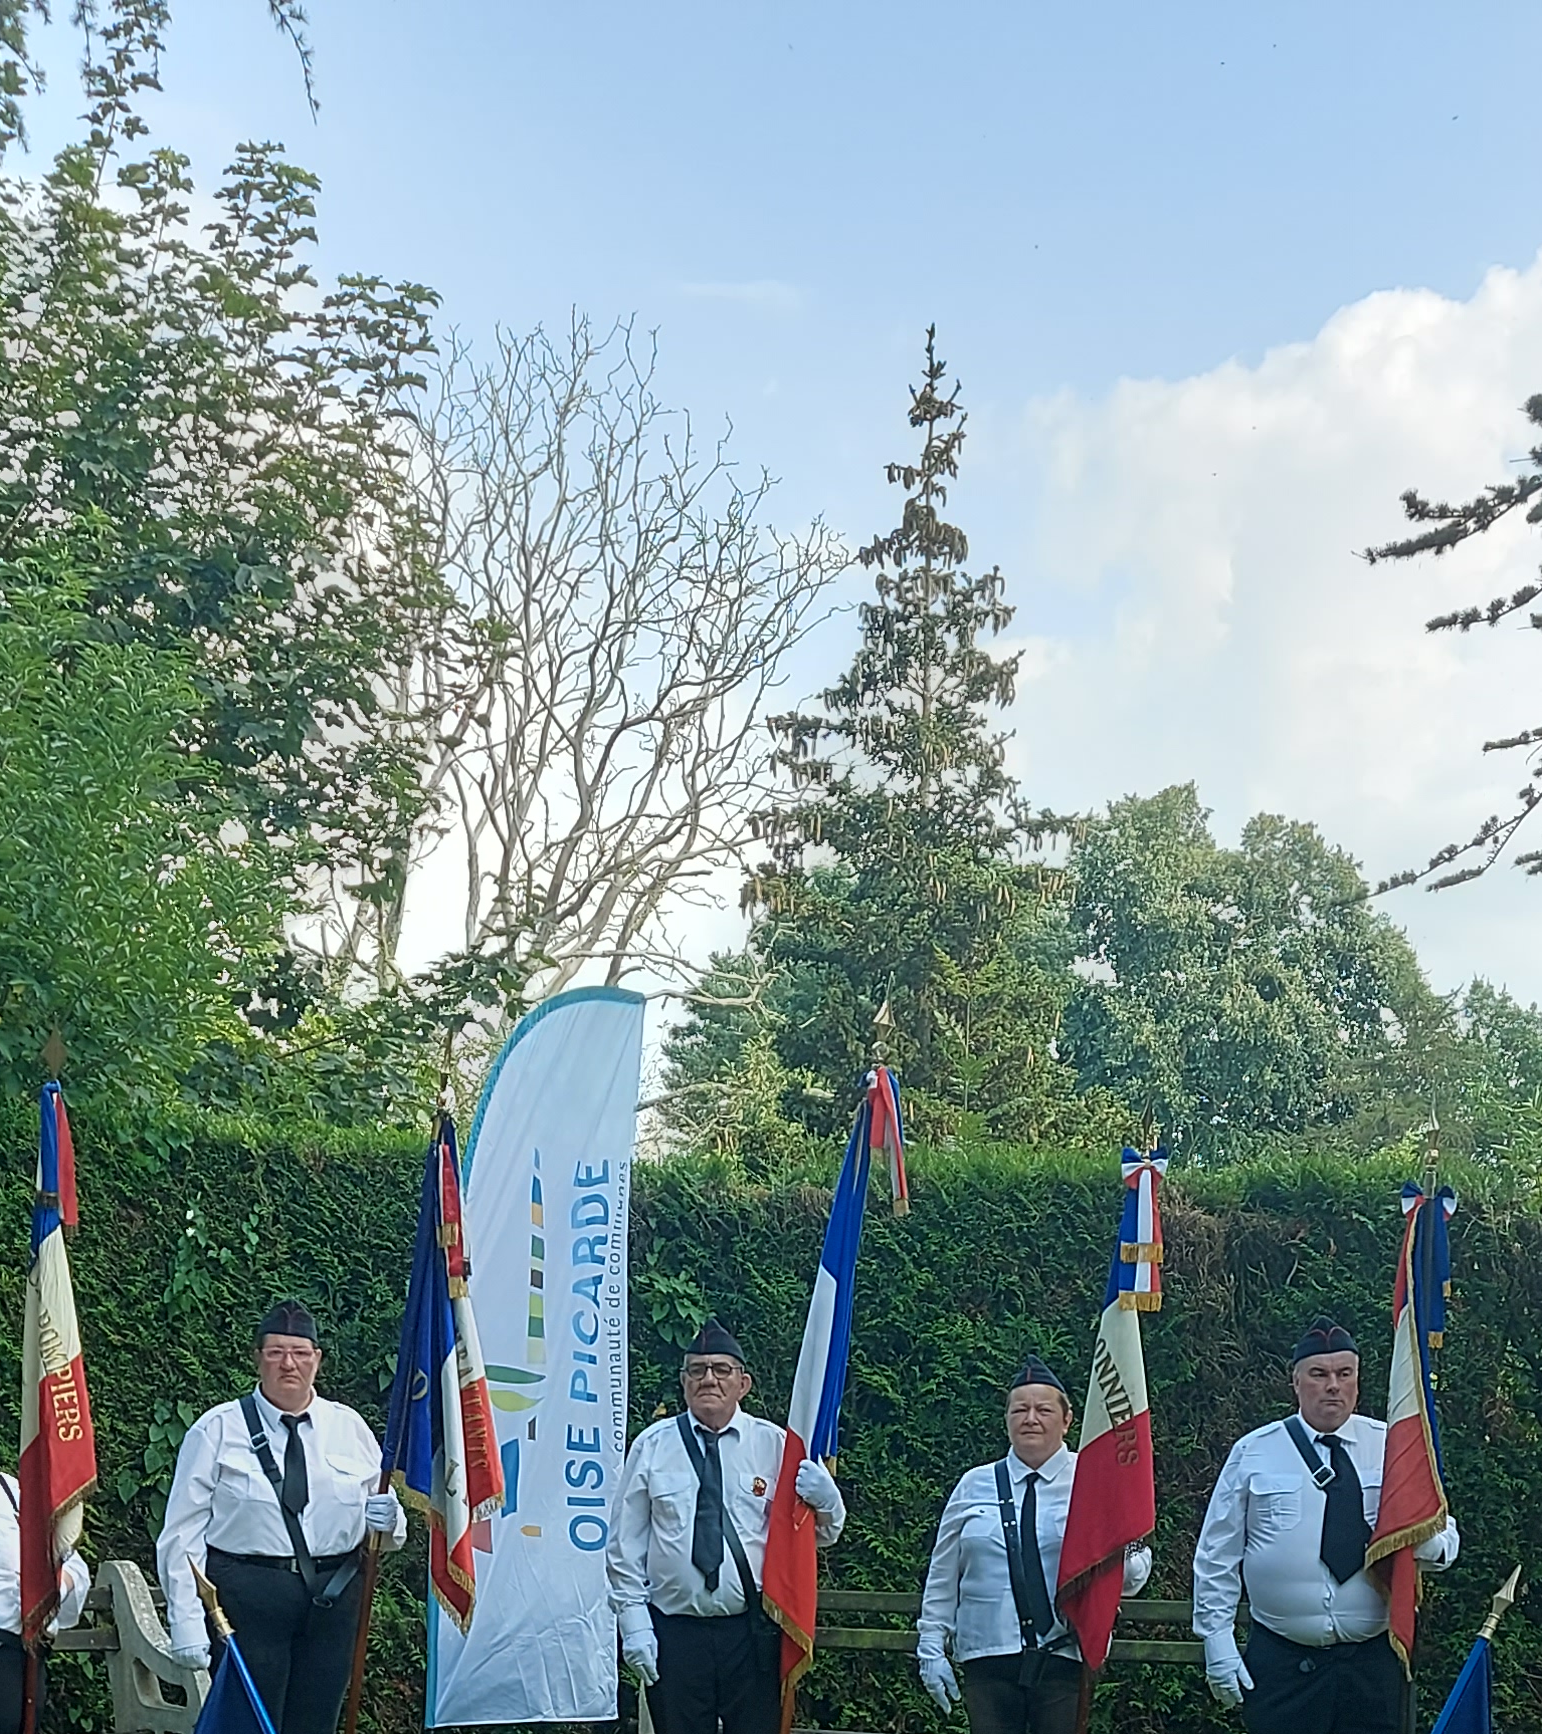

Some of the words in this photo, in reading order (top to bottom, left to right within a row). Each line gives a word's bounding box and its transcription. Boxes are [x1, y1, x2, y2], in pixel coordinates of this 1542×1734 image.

[570, 1159, 609, 1403] PICARDE
[610, 1161, 628, 1276] communes
[605, 1284, 621, 1309] de
[604, 1317, 624, 1452] communauté
[565, 1424, 608, 1552] OISE
